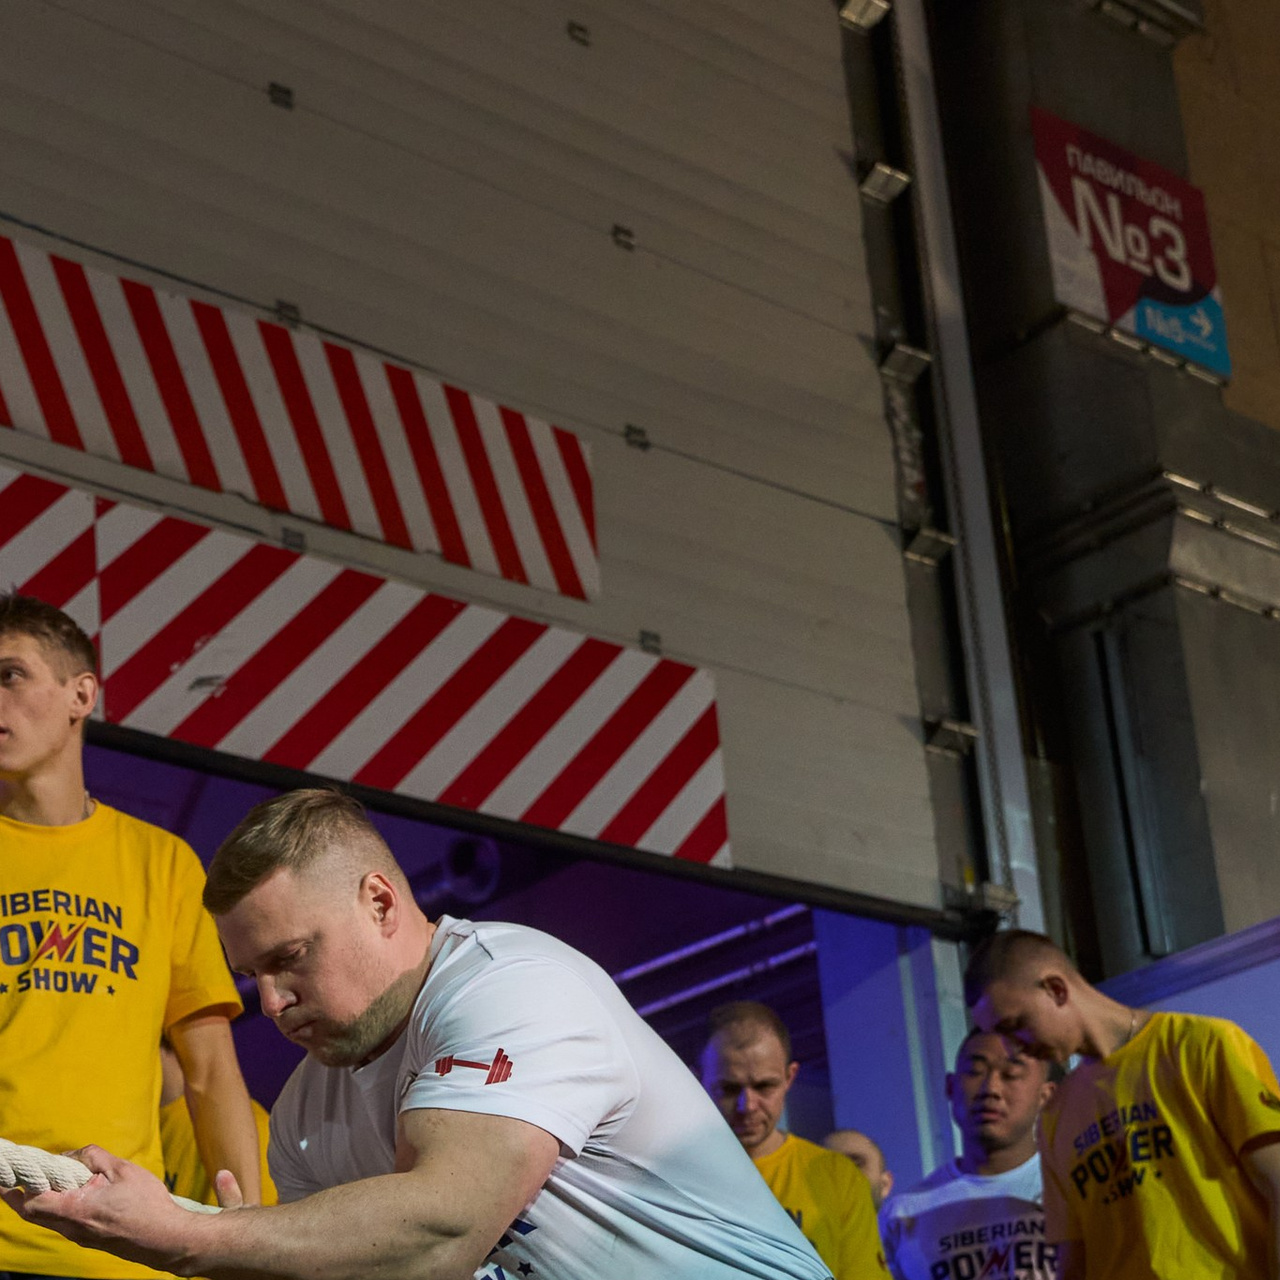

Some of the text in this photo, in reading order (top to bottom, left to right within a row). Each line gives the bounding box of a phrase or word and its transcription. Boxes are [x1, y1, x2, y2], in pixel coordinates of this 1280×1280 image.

[1066, 143, 1184, 222] ПАВИЛЬОН
[17, 967, 98, 995] SHOW
[938, 1220, 1046, 1255] SIBERIAN
